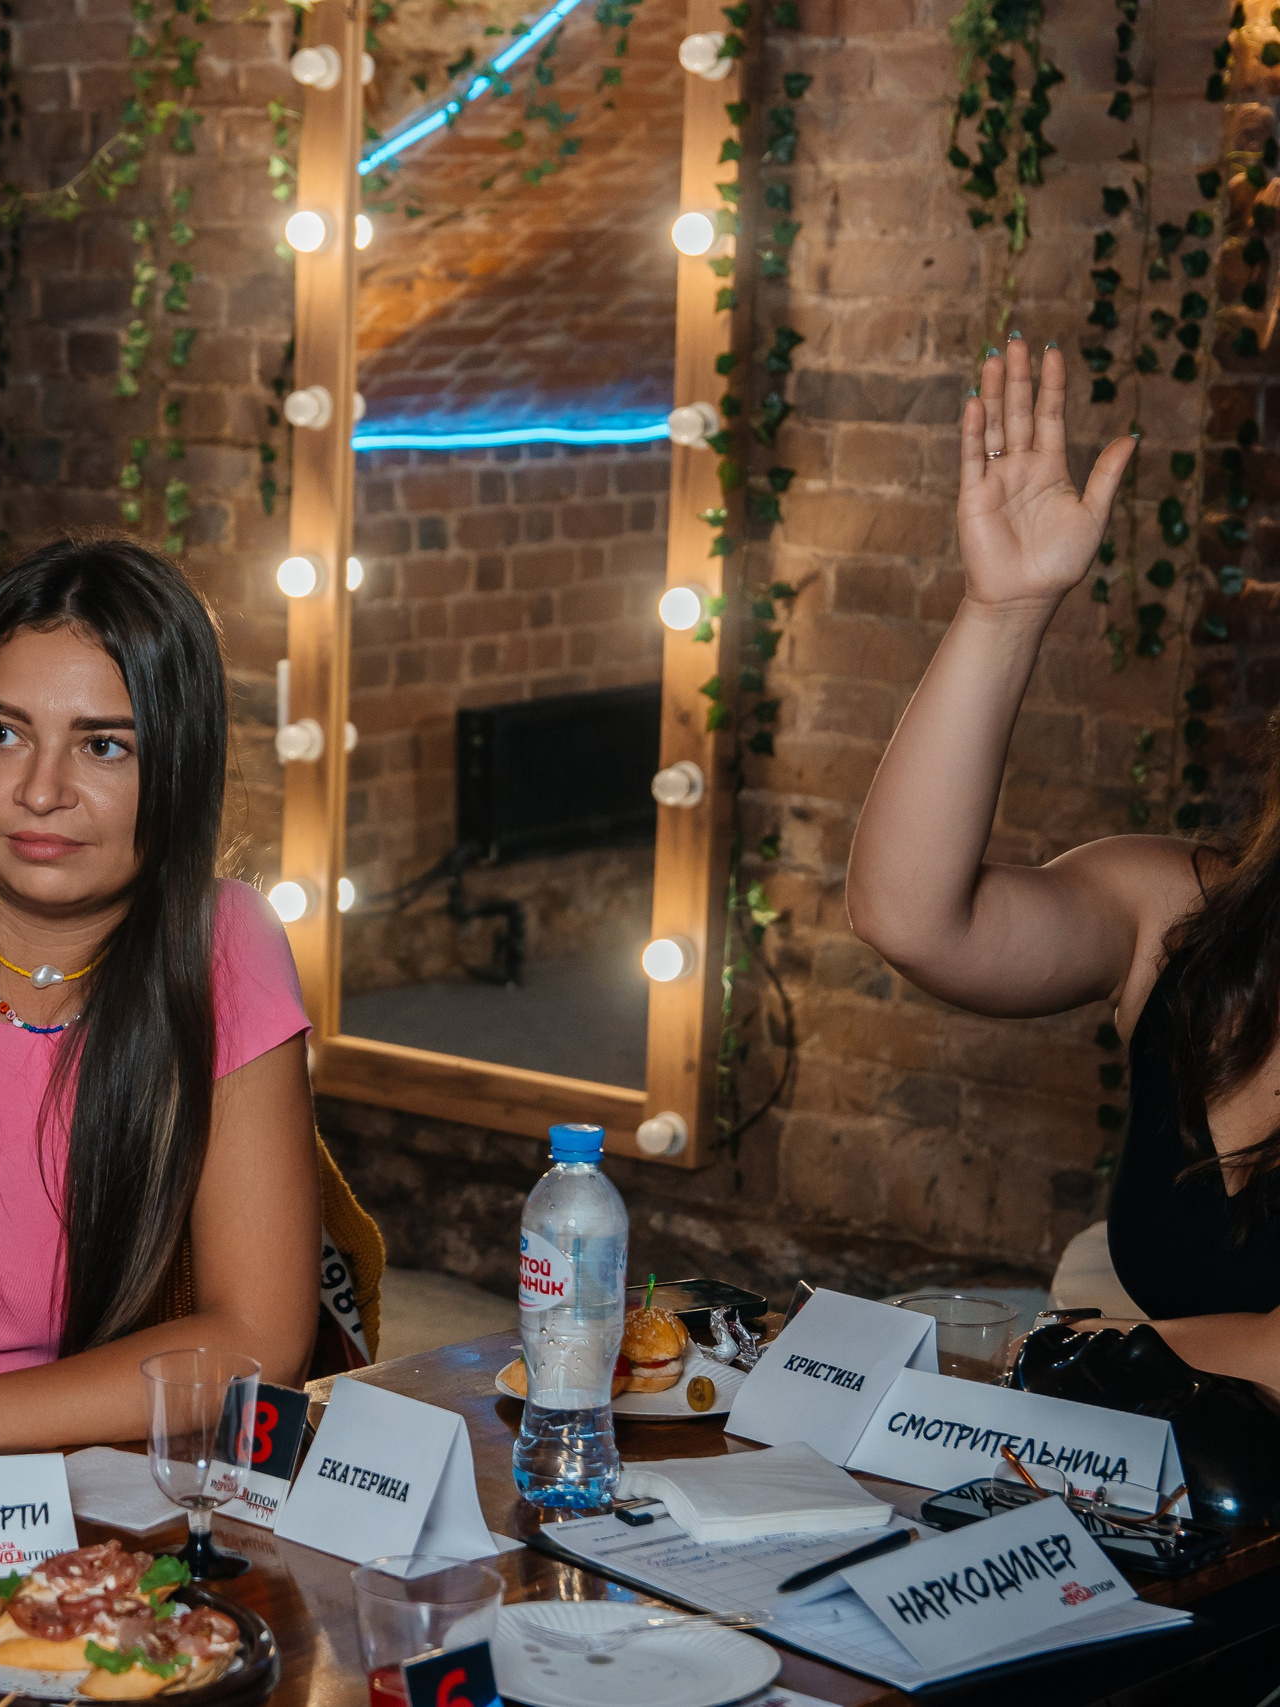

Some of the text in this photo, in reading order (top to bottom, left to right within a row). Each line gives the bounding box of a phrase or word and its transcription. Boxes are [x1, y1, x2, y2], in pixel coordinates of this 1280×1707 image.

[783, 1354, 866, 1392] КРИСТИНА
[234, 1400, 279, 1464] 8
[887, 1411, 1130, 1484] СМОТРИТЕЛЬНИЦА
[317, 1457, 410, 1503] ЕКАТЕРИНА
[886, 1533, 1077, 1625] НАРКОДИЛЕР
[436, 1667, 475, 1707] 6
